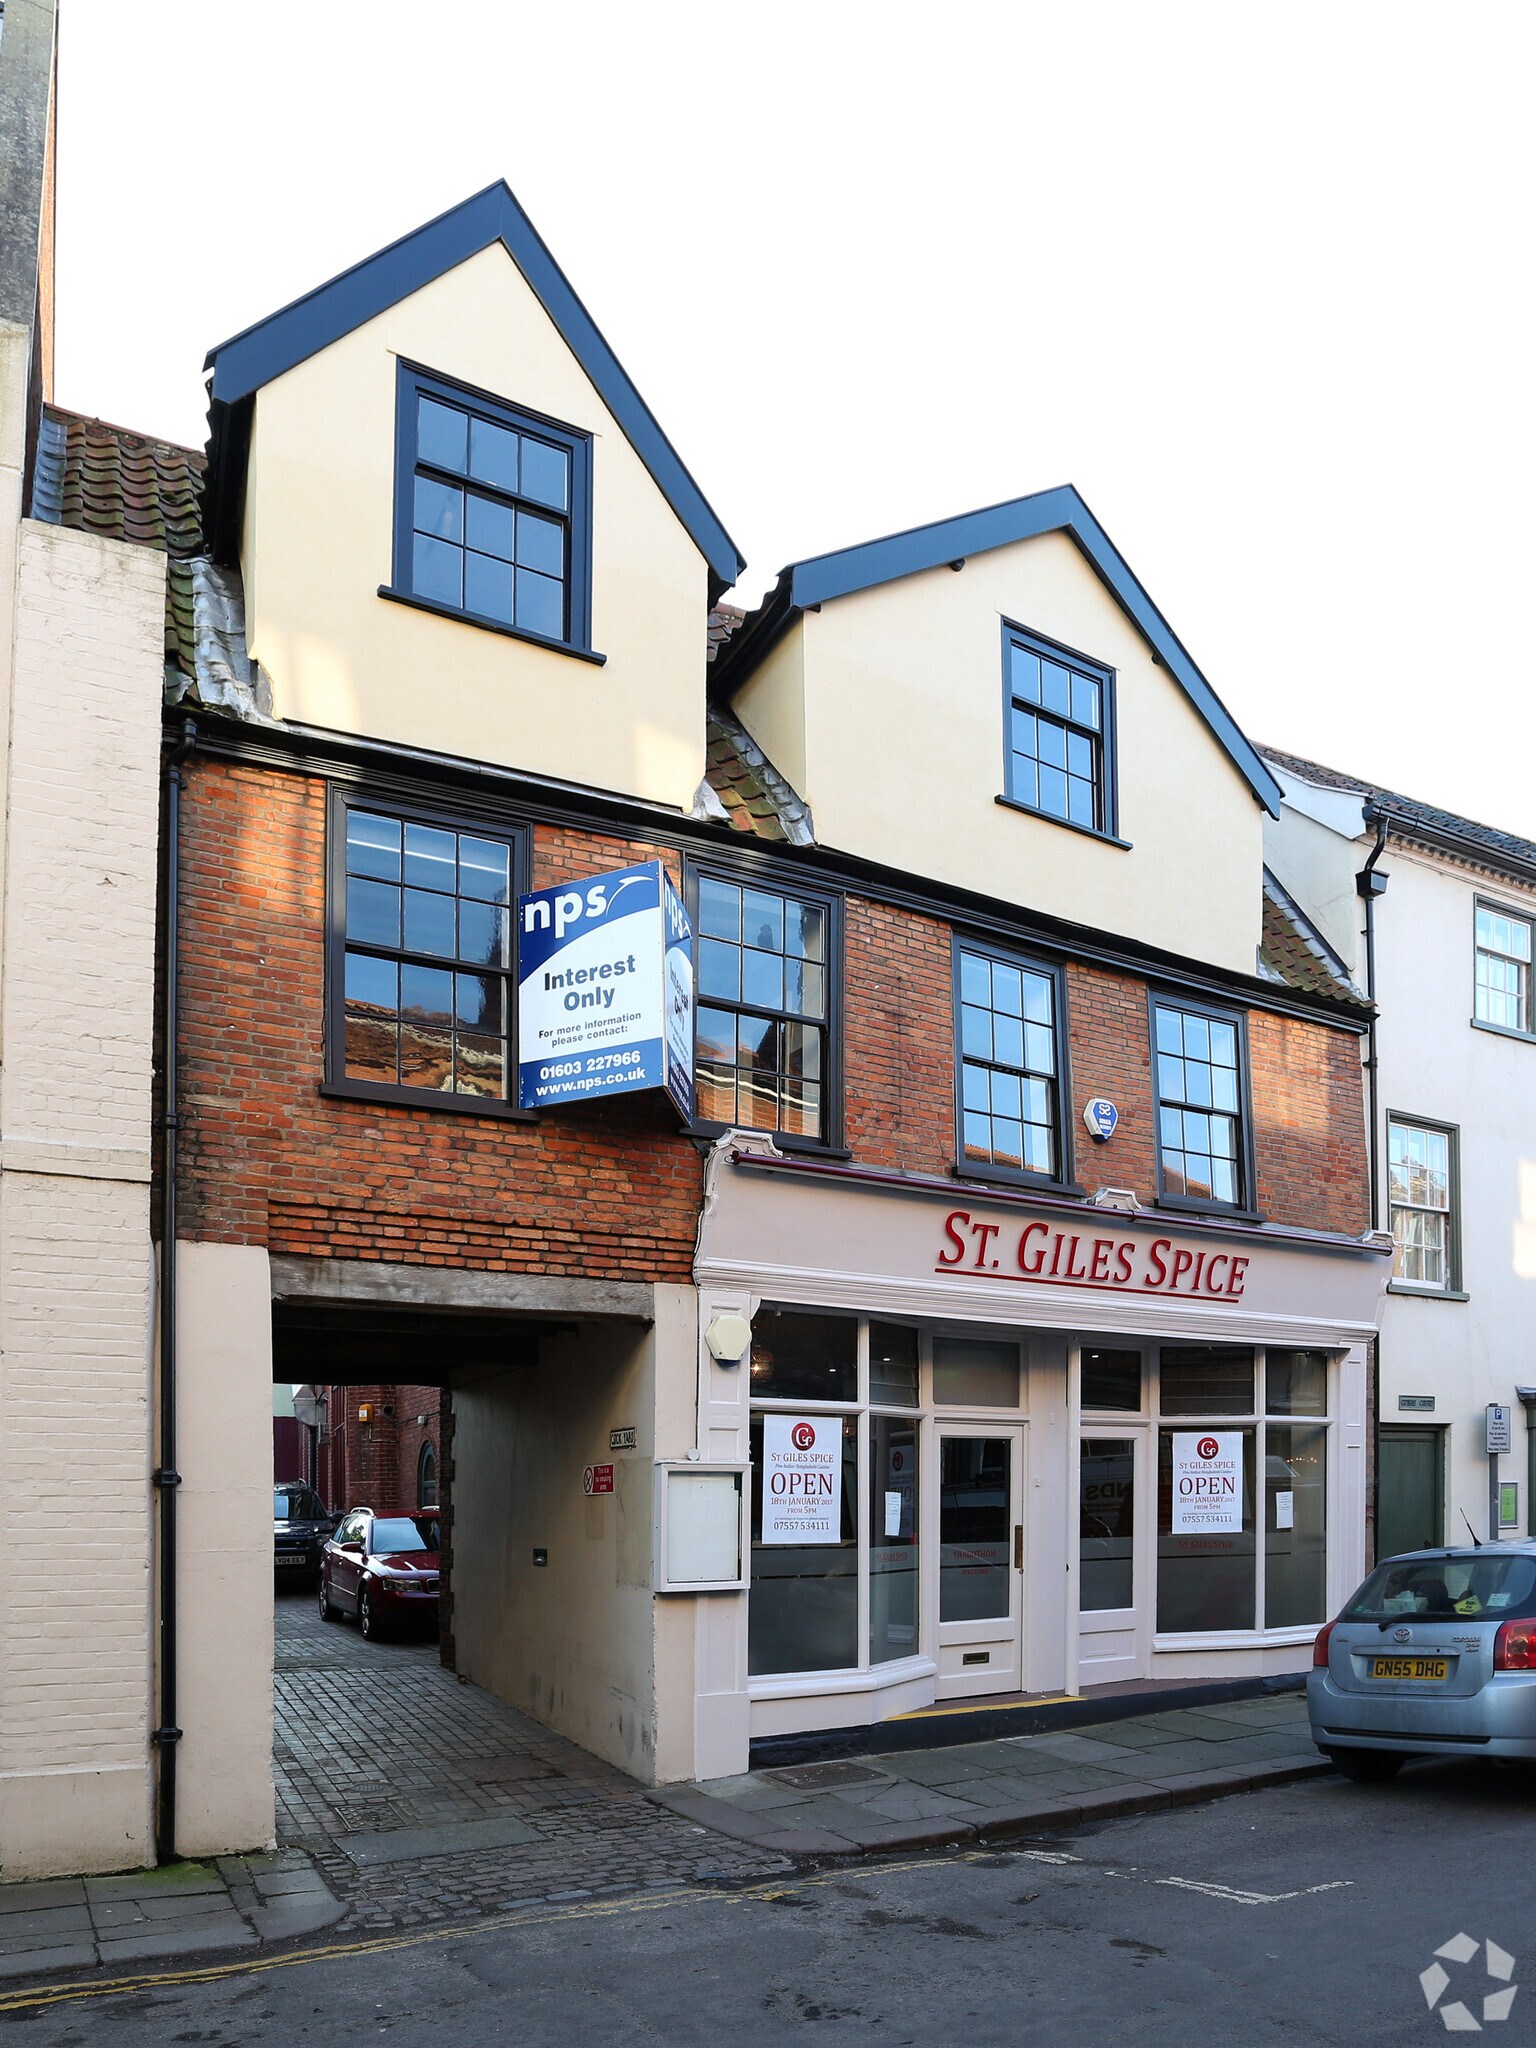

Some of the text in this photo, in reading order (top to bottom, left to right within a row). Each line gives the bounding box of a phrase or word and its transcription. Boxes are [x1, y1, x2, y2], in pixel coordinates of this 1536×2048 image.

[525, 885, 607, 939] nps
[544, 954, 636, 991] Interest
[563, 986, 616, 1011] Only
[538, 1012, 642, 1039] For more information
[551, 1025, 629, 1048] please contact:
[540, 1050, 641, 1081] 01603 227966
[535, 1066, 647, 1097] www.nps.co.uk
[783, 1452, 808, 1463] GILES
[809, 1453, 834, 1463] SPICE
[1189, 1461, 1213, 1469] GILES
[1213, 1461, 1236, 1469] SPICE
[770, 1472, 834, 1495] OPEN
[1179, 1476, 1236, 1496] OPEN
[788, 1497, 820, 1507] JANUARY
[1194, 1496, 1225, 1504] JANUARY
[773, 1521, 829, 1531] 07557 534111
[1182, 1515, 1232, 1523] 07557 534111
[1375, 1660, 1445, 1678] GN55 DHG
